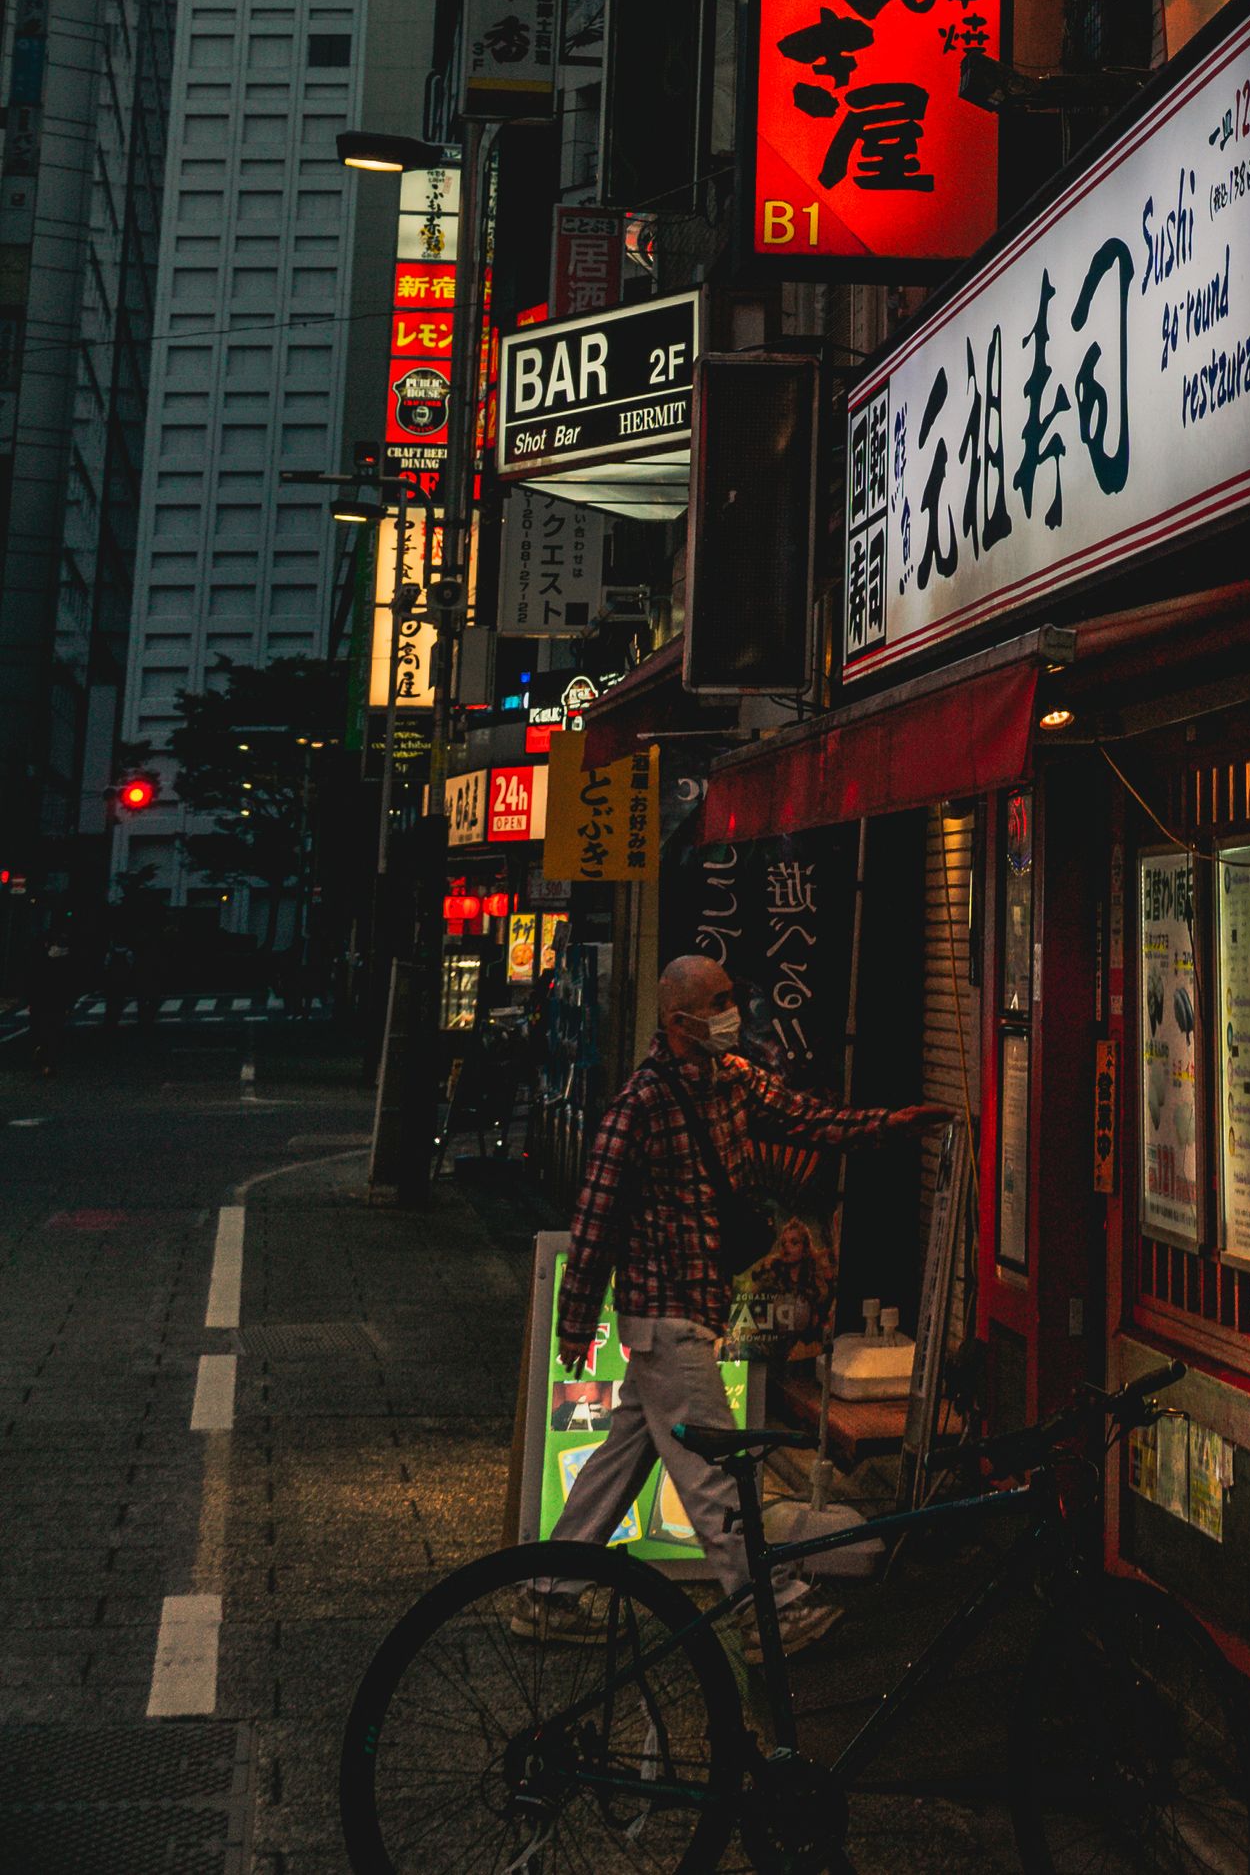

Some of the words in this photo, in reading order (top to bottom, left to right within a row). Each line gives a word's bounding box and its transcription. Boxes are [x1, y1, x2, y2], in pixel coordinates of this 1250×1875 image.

[763, 200, 819, 246] B1
[1141, 167, 1196, 297] Sushi
[1160, 243, 1231, 373] go-round
[396, 321, 454, 348] レモン
[405, 378, 443, 388] PUBLIC
[406, 388, 442, 399] HOUSE
[514, 331, 609, 414] BAR
[649, 342, 686, 385] 2F
[513, 428, 548, 455] Shot
[553, 424, 582, 448] Bar
[618, 400, 687, 436] HERMIT
[917, 236, 1135, 591] 元祖寿司
[386, 446, 422, 459] CRAFT
[400, 457, 440, 470] DINING
[396, 618, 421, 699] 日高屋
[493, 774, 529, 813] 24h
[496, 817, 523, 830] OPEN
